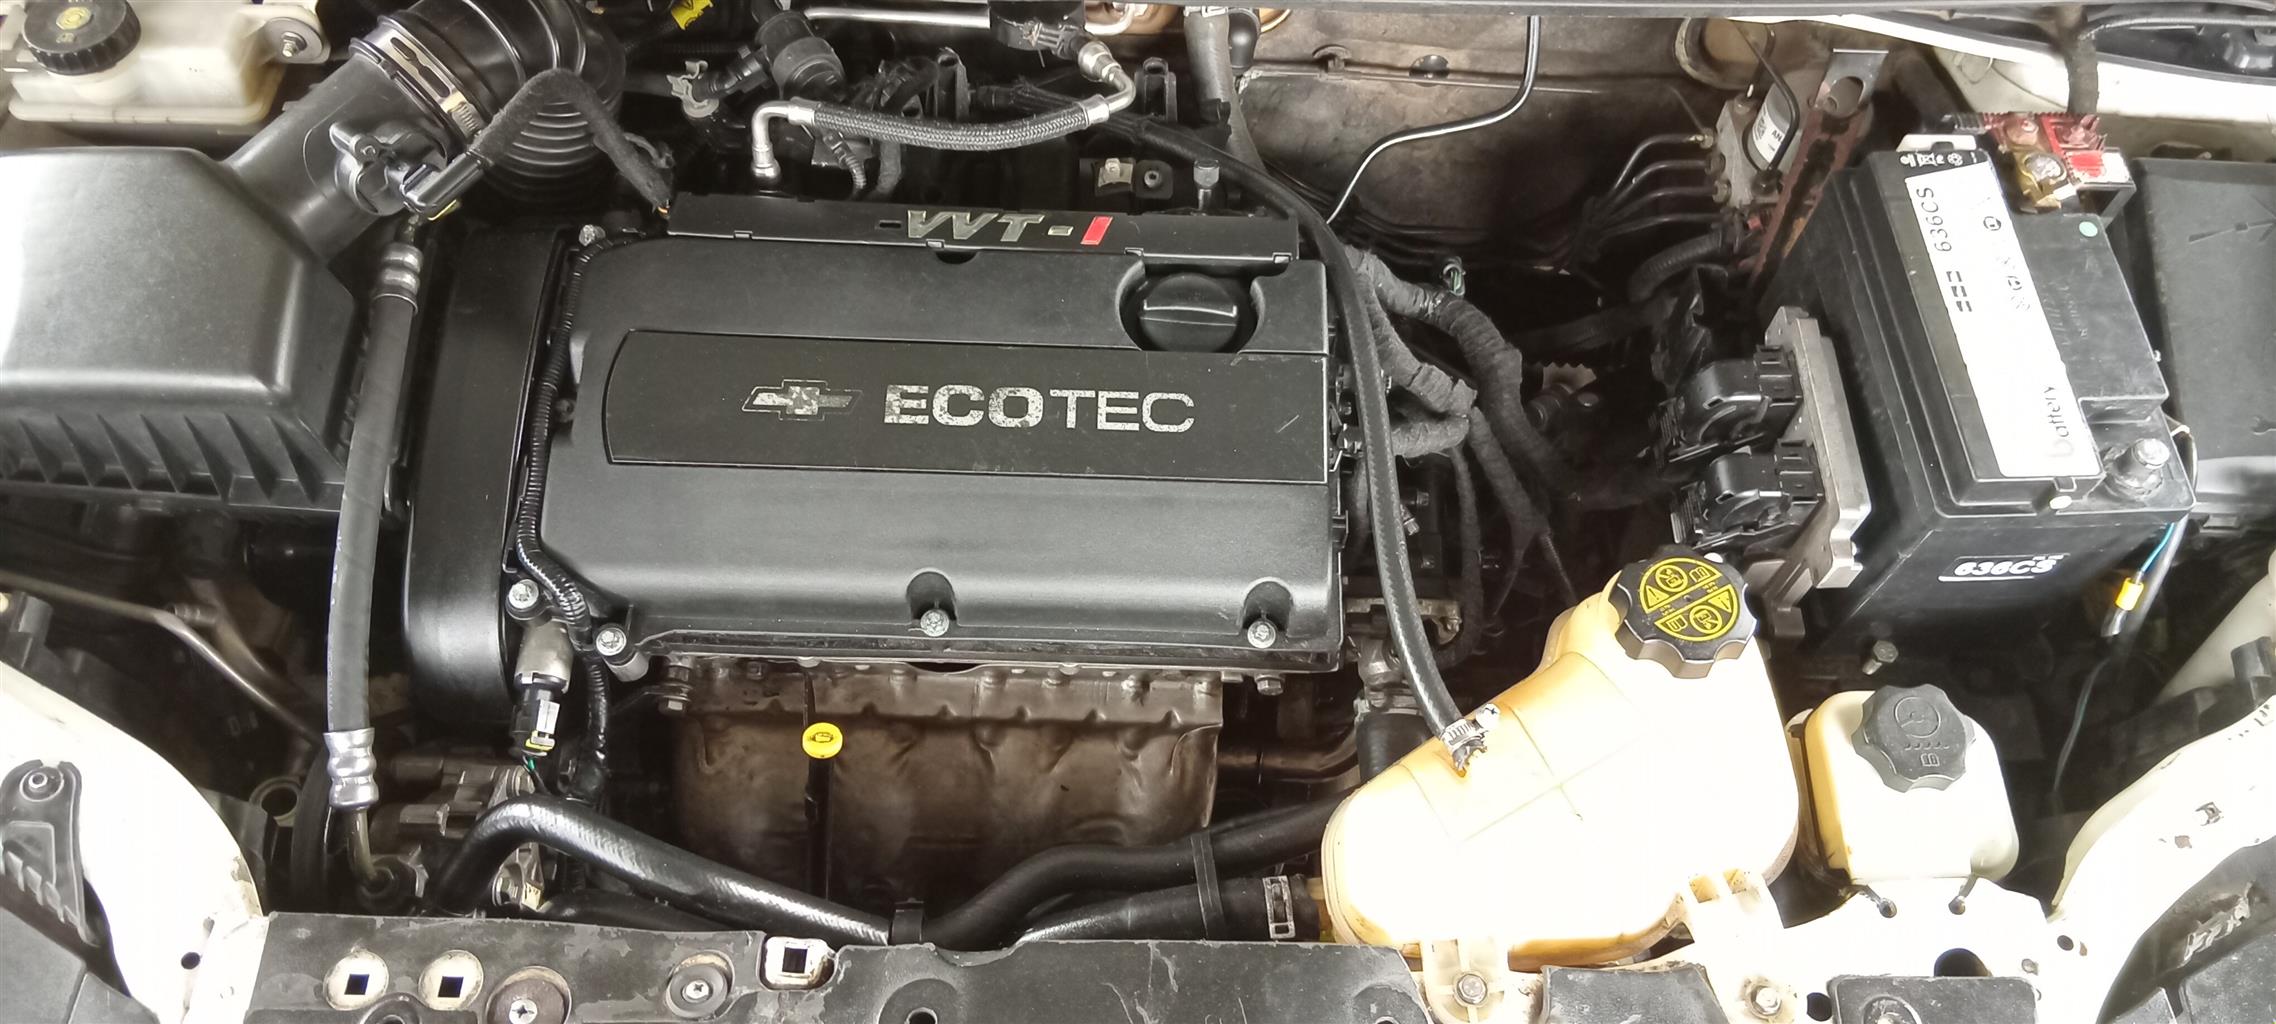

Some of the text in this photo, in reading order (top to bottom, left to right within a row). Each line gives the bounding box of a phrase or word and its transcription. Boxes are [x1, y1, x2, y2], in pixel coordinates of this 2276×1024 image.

[1916, 187, 1952, 252] 636CS
[884, 384, 1195, 433] ECOTEC
[1954, 559, 2057, 576] 636CS
